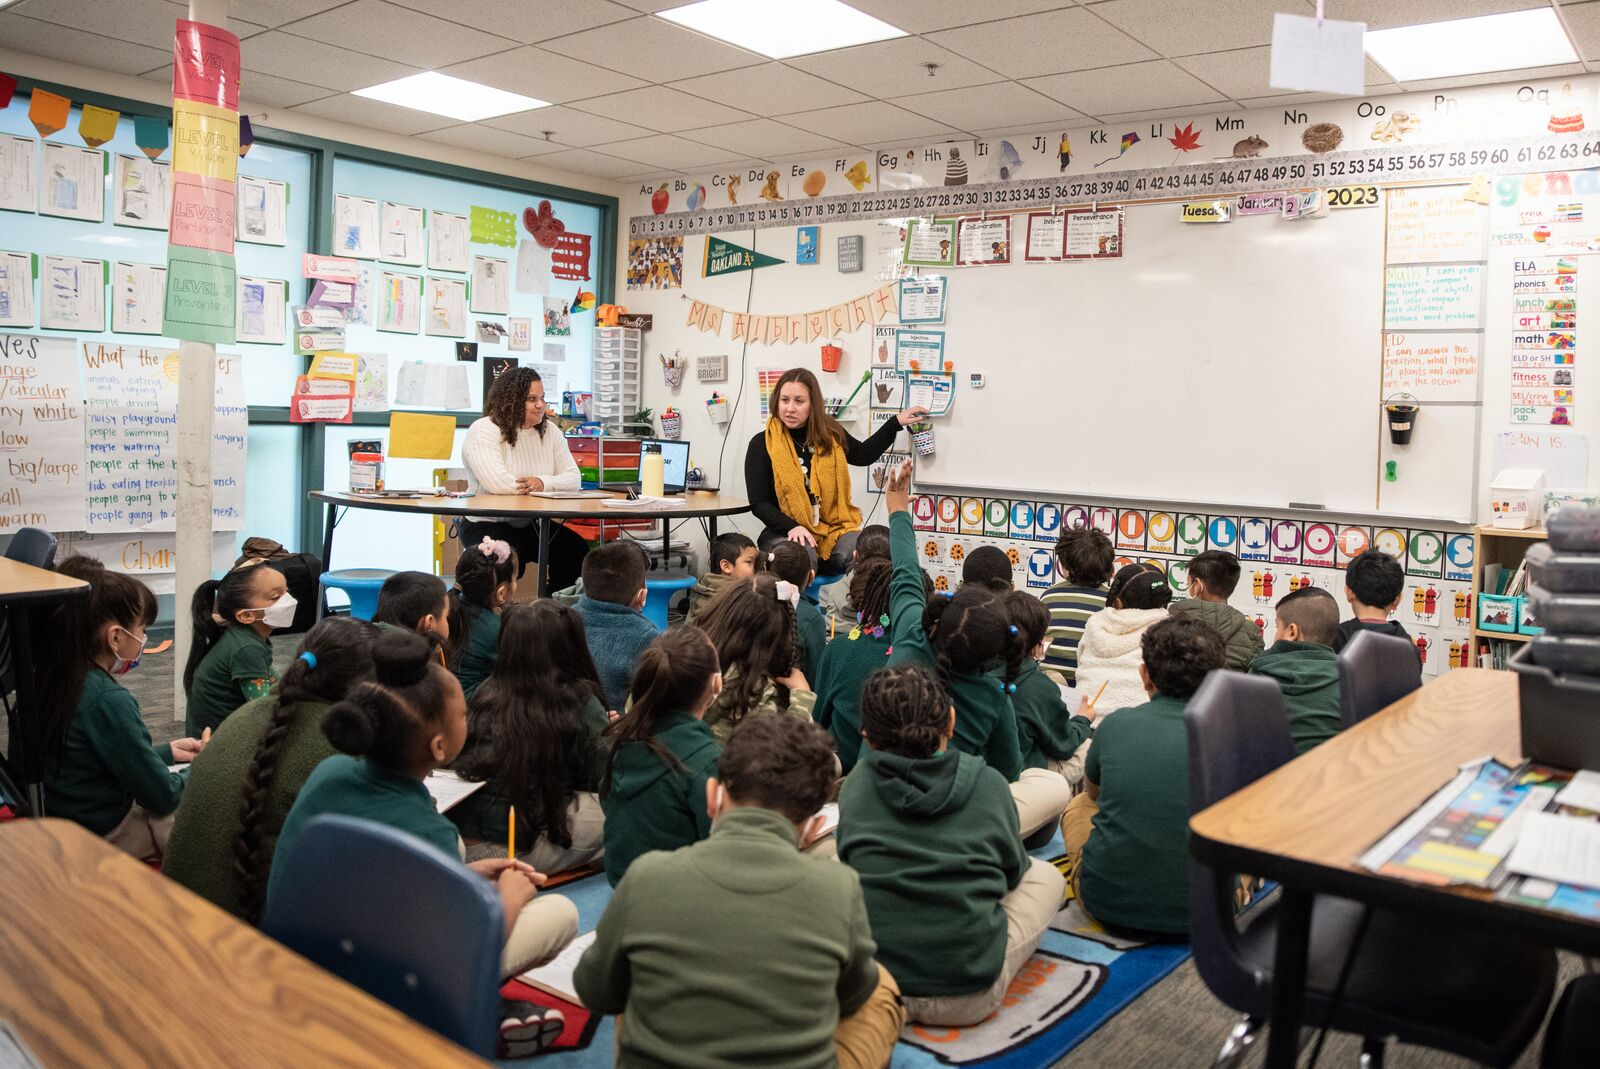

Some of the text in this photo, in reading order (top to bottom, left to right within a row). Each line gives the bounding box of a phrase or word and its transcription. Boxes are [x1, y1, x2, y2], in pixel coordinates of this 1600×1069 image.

[179, 128, 236, 153] LEVEL 1
[640, 86, 1549, 195] Aa Bb Cc Dd Ee Ff Gg Hh Ii Jj Kk Ll Mm Nn Oo Pp Qq
[631, 142, 1600, 233] 0 1 2 3 4 5 6 7 8 9 10 11 12 13 14 15 16 17 18 19 20 21 22 23 24 25 26 27 28 29 30 31 32 33 34 35 36 37 38 39 40 41 42 43 44 45 46 47 48 49 50 51 52 53 54 55 56 57 58 59 60 61 62 63 64
[1327, 187, 1378, 206] 2023
[176, 202, 232, 226] LEVEL 2
[1286, 202, 1294, 212] 2
[711, 252, 742, 273] OAKLAND
[1515, 262, 1536, 271] ELA
[173, 278, 232, 298] LEVEL 3
[1514, 280, 1546, 291] phonics
[1516, 298, 1544, 307] lunch
[691, 301, 717, 328] Ms
[736, 291, 889, 340] Albrecht
[1519, 316, 1540, 326] art
[1515, 334, 1544, 343] math
[84, 344, 158, 369] What the
[1513, 372, 1546, 381] fitness
[34, 404, 78, 420] white
[122, 414, 176, 426] playground
[1513, 406, 1536, 416] pack
[1517, 414, 1528, 422] up
[89, 427, 169, 443] people swimming
[90, 443, 160, 456] people walking
[8, 457, 79, 484] big/large
[89, 458, 170, 476] people at the
[89, 492, 168, 507] people going to
[918, 498, 932, 516] A
[943, 499, 953, 516] B
[89, 510, 169, 524] people going to
[964, 501, 977, 521] C
[991, 502, 1003, 521] D
[1017, 506, 1028, 525] E
[1042, 505, 1055, 529] F
[1128, 515, 1136, 535] I
[1153, 516, 1167, 537] J
[1184, 516, 1203, 542] K
[1218, 521, 1229, 543] L
[1245, 523, 1267, 545] M
[1278, 522, 1297, 547] N
[1307, 528, 1332, 552] O
[1346, 530, 1364, 553] P
[1417, 534, 1436, 562] R
[1454, 534, 1472, 563] S
[1032, 554, 1050, 575] T
